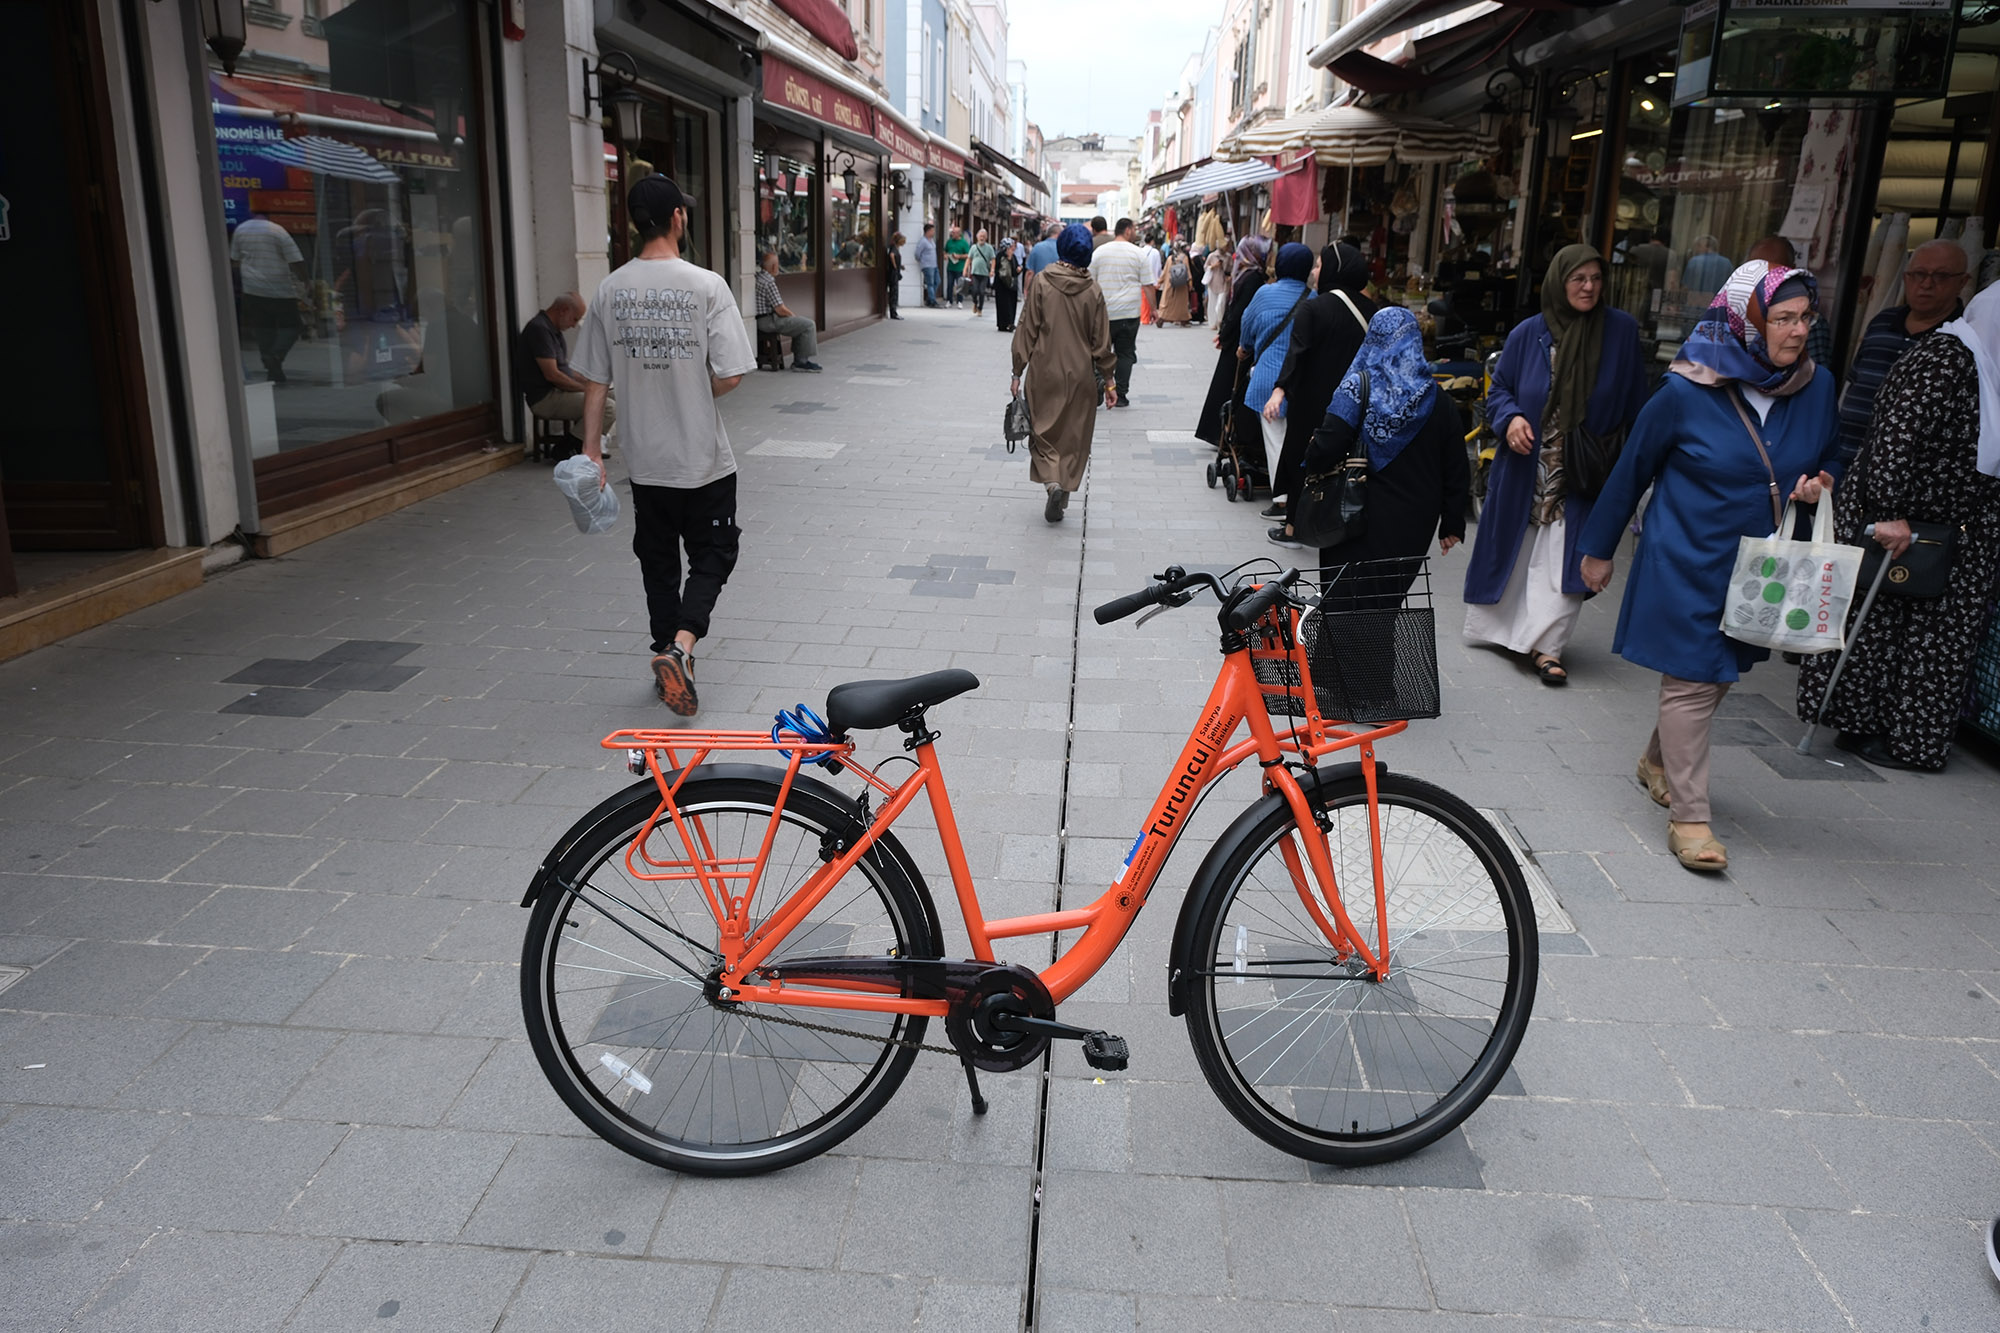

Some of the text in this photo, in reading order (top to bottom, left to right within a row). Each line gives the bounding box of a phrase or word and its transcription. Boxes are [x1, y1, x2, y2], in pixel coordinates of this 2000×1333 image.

[1816, 562, 1835, 633] BOYNER
[1200, 705, 1221, 737] Sakarya
[1207, 720, 1223, 742] Şehir
[1214, 714, 1236, 746] Bisikleti
[1149, 748, 1210, 838] Turuncu
